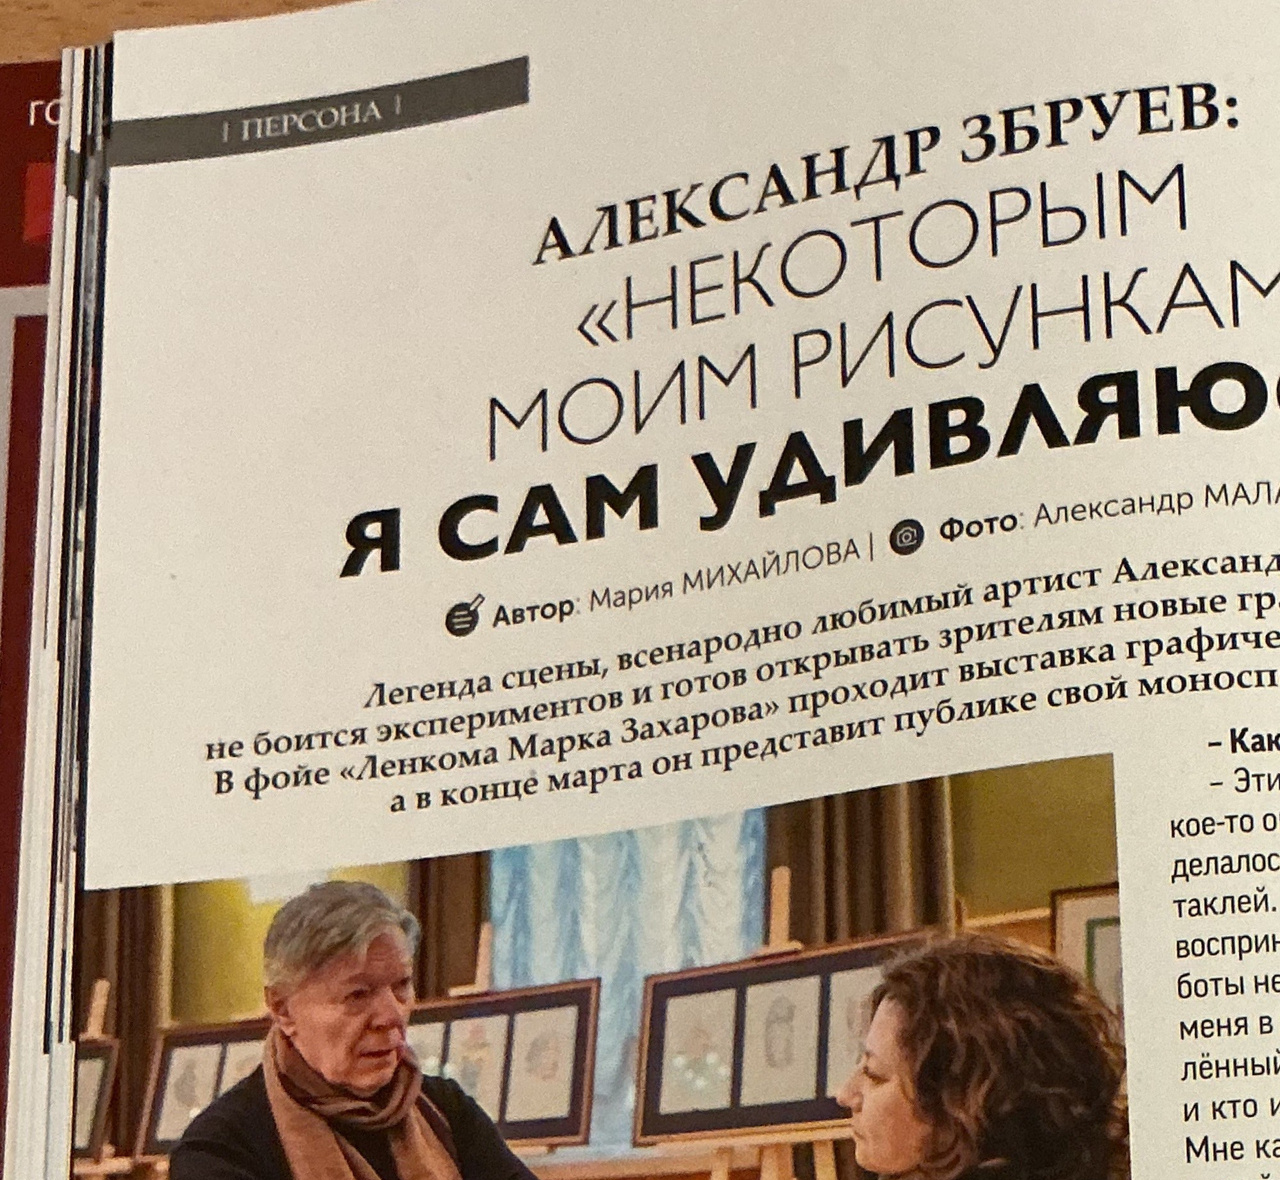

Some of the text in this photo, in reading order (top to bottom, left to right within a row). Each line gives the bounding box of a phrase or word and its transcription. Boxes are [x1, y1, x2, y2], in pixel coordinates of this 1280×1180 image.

[241, 100, 383, 142] ПЕРСОНА
[531, 81, 1240, 267] АЛЕКСАНДР ЗБРУЕВ:
[576, 162, 1188, 347] «НЕКОТОРЫМ
[488, 342, 757, 462] МОИМ
[338, 506, 402, 579] Я
[437, 462, 659, 562] САМ
[939, 511, 1025, 543] Фото:
[1033, 491, 1194, 529] Александр
[362, 674, 494, 709] Легенда
[501, 657, 609, 690] сцены,
[616, 620, 803, 671] всенародно
[811, 582, 974, 635] любимый
[982, 567, 1103, 609] артист
[491, 537, 861, 629] Автор: Мария МИХАЙЛОВА
[204, 738, 245, 762] не
[252, 726, 369, 756] боится
[375, 690, 624, 743] экспериментов
[631, 685, 653, 706] и
[660, 667, 748, 701] готов
[755, 634, 930, 683] открывать
[938, 605, 1104, 655] зрителям
[1112, 594, 1228, 623] новые
[214, 769, 235, 796] В
[243, 764, 331, 801] фойе
[339, 746, 499, 782] «Ленкома
[507, 728, 613, 763] Марка
[620, 700, 780, 744] Захарова»
[787, 667, 950, 719] проходит
[957, 642, 1117, 683] выставка
[389, 793, 407, 814] а
[415, 791, 432, 810] в
[440, 776, 539, 808] конце
[547, 760, 644, 795] марта
[651, 751, 693, 776] он
[700, 716, 886, 773] представит
[893, 691, 1038, 738] публике
[1046, 674, 1129, 708] свой
[1169, 813, 1255, 839] кое-то
[1176, 971, 1246, 1000] боты
